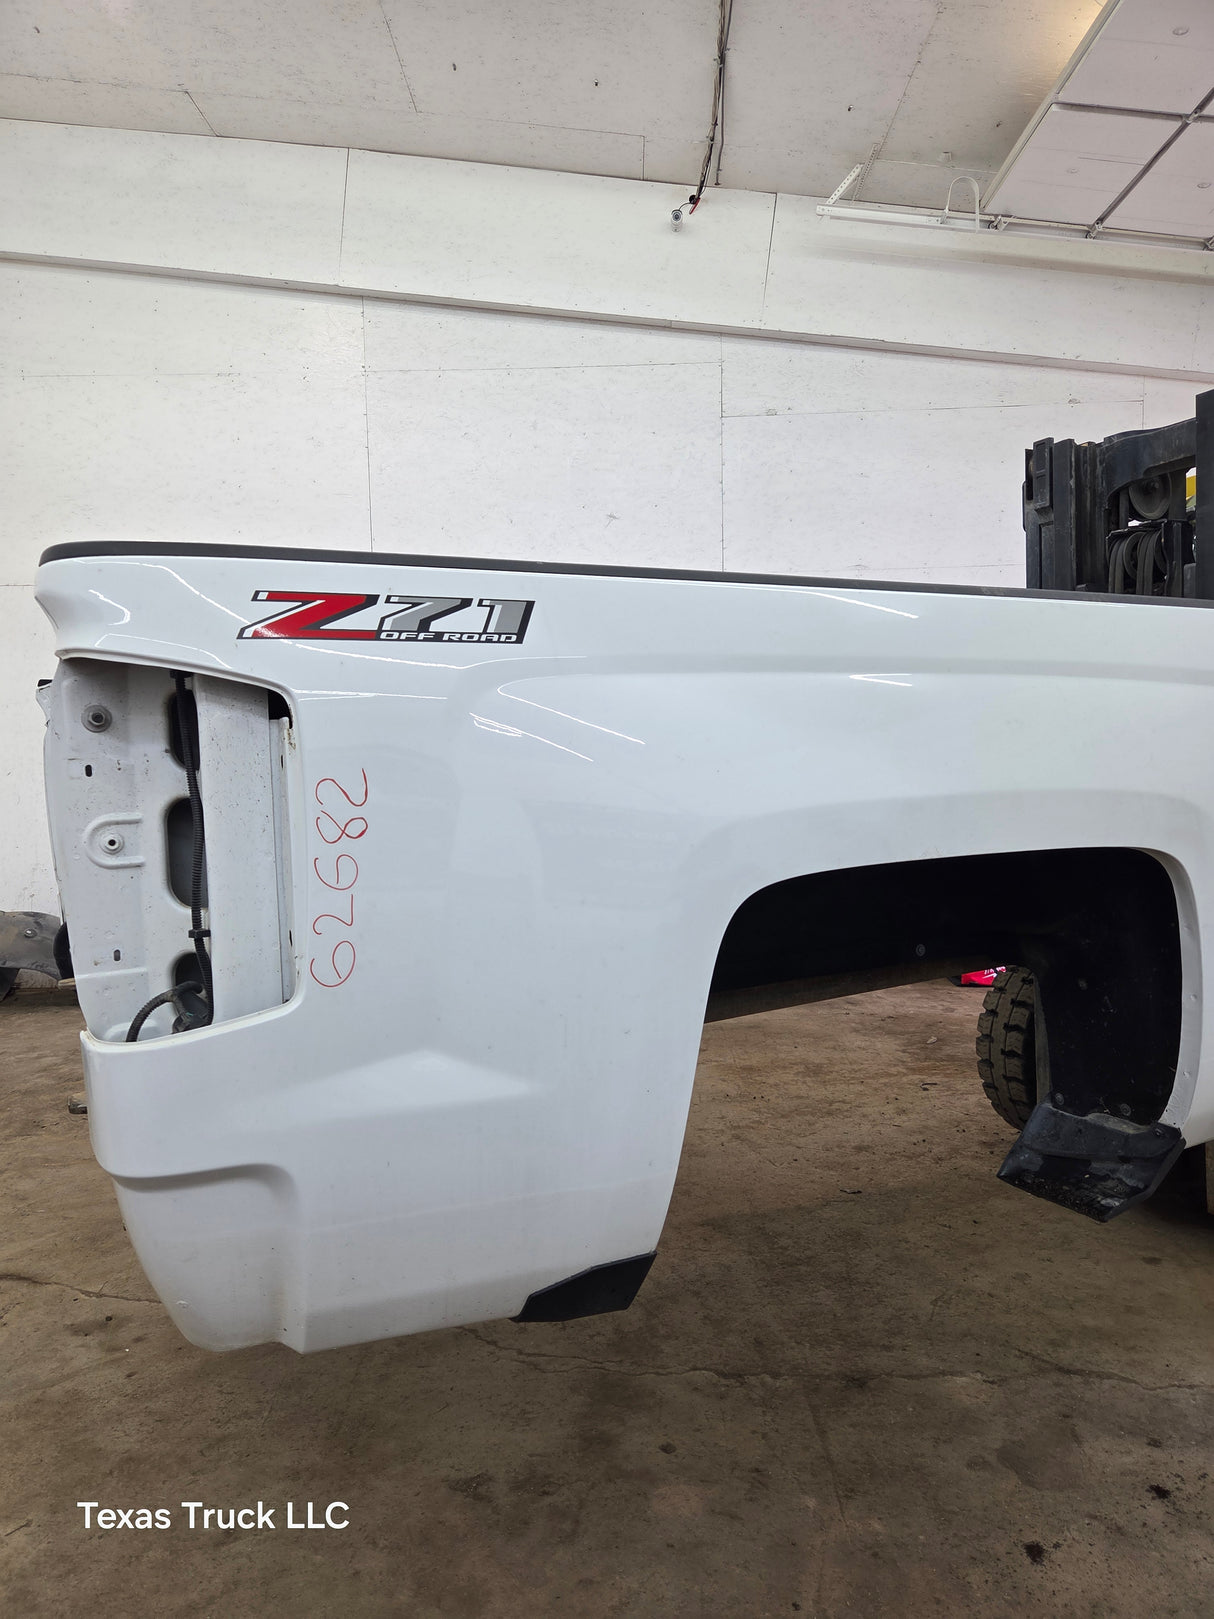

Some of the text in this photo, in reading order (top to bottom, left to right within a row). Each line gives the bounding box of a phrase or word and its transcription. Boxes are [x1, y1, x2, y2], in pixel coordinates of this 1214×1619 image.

[236, 590, 536, 644] Z71
[380, 631, 518, 642] OFF ROAD
[310, 768, 368, 987] 62682
